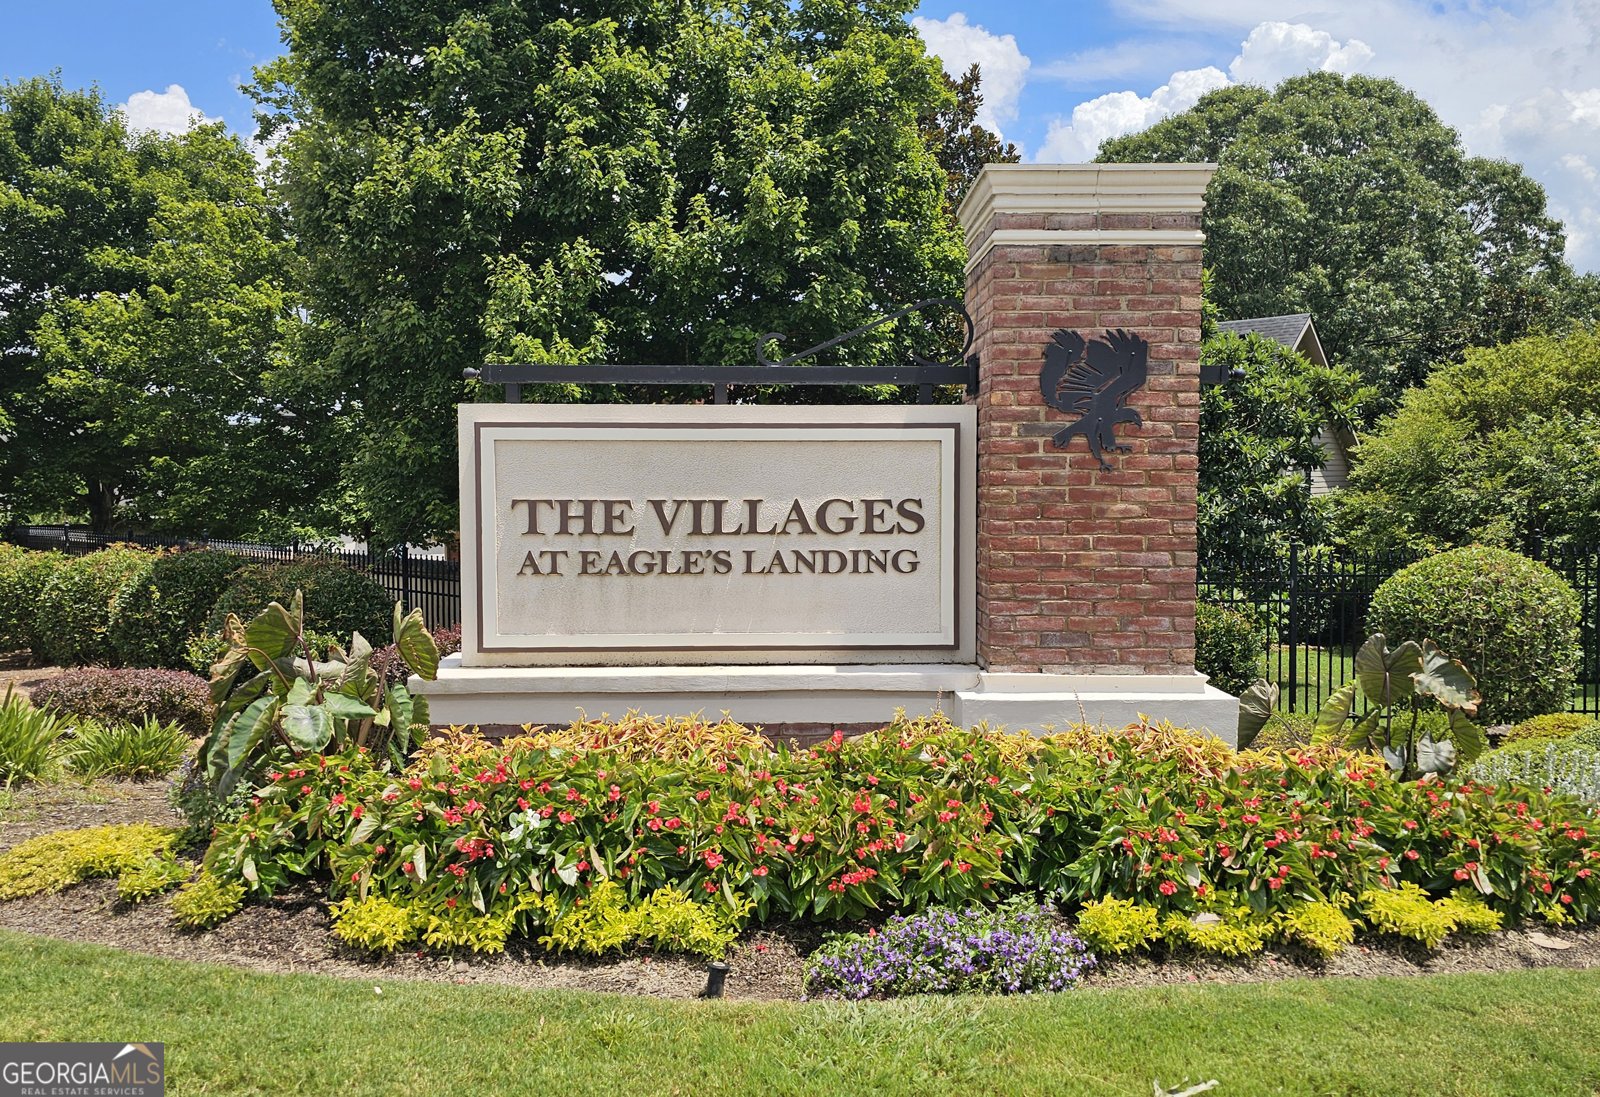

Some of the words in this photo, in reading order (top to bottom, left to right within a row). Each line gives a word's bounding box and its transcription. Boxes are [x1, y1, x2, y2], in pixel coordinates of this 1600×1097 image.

[511, 498, 635, 537] THE
[646, 497, 926, 537] VILLAGES
[516, 549, 569, 577] AT
[577, 548, 733, 576] EAGLE'S
[742, 548, 921, 575] LANDING
